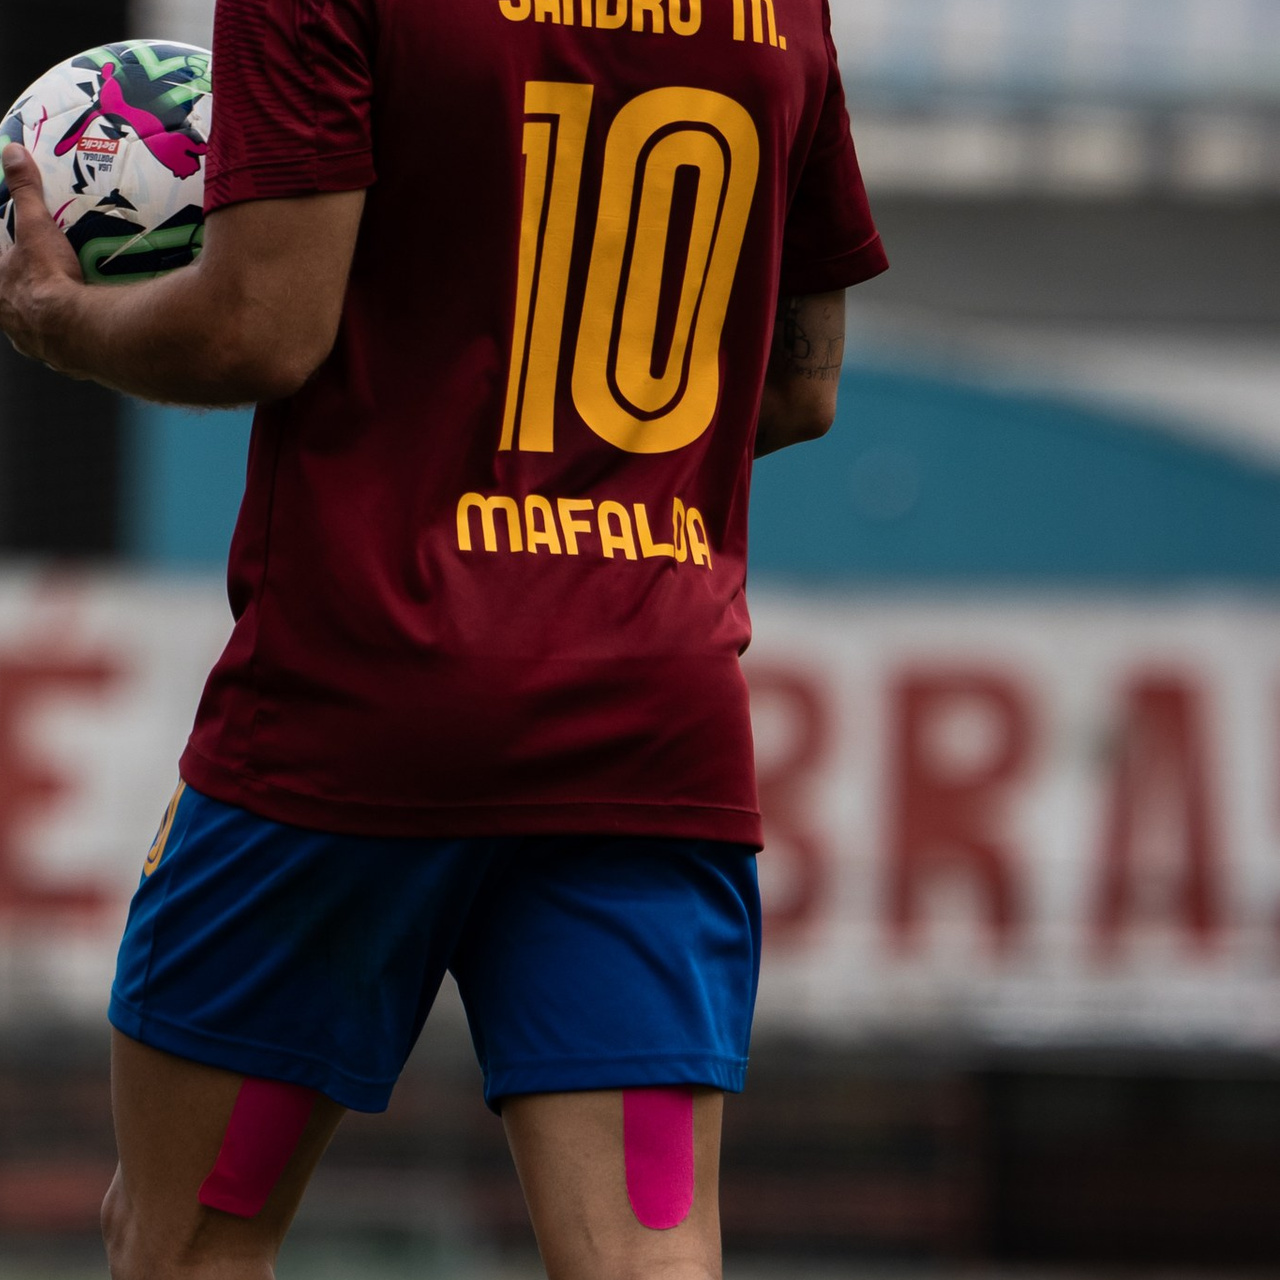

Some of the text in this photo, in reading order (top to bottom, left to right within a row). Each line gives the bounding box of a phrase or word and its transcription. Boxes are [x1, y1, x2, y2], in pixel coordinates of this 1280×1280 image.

[80, 138, 118, 151] Betclic
[82, 152, 114, 163] PORTUGAL
[98, 163, 113, 173] LIGA
[498, 80, 761, 455] 10
[455, 491, 713, 571] MAFALDA
